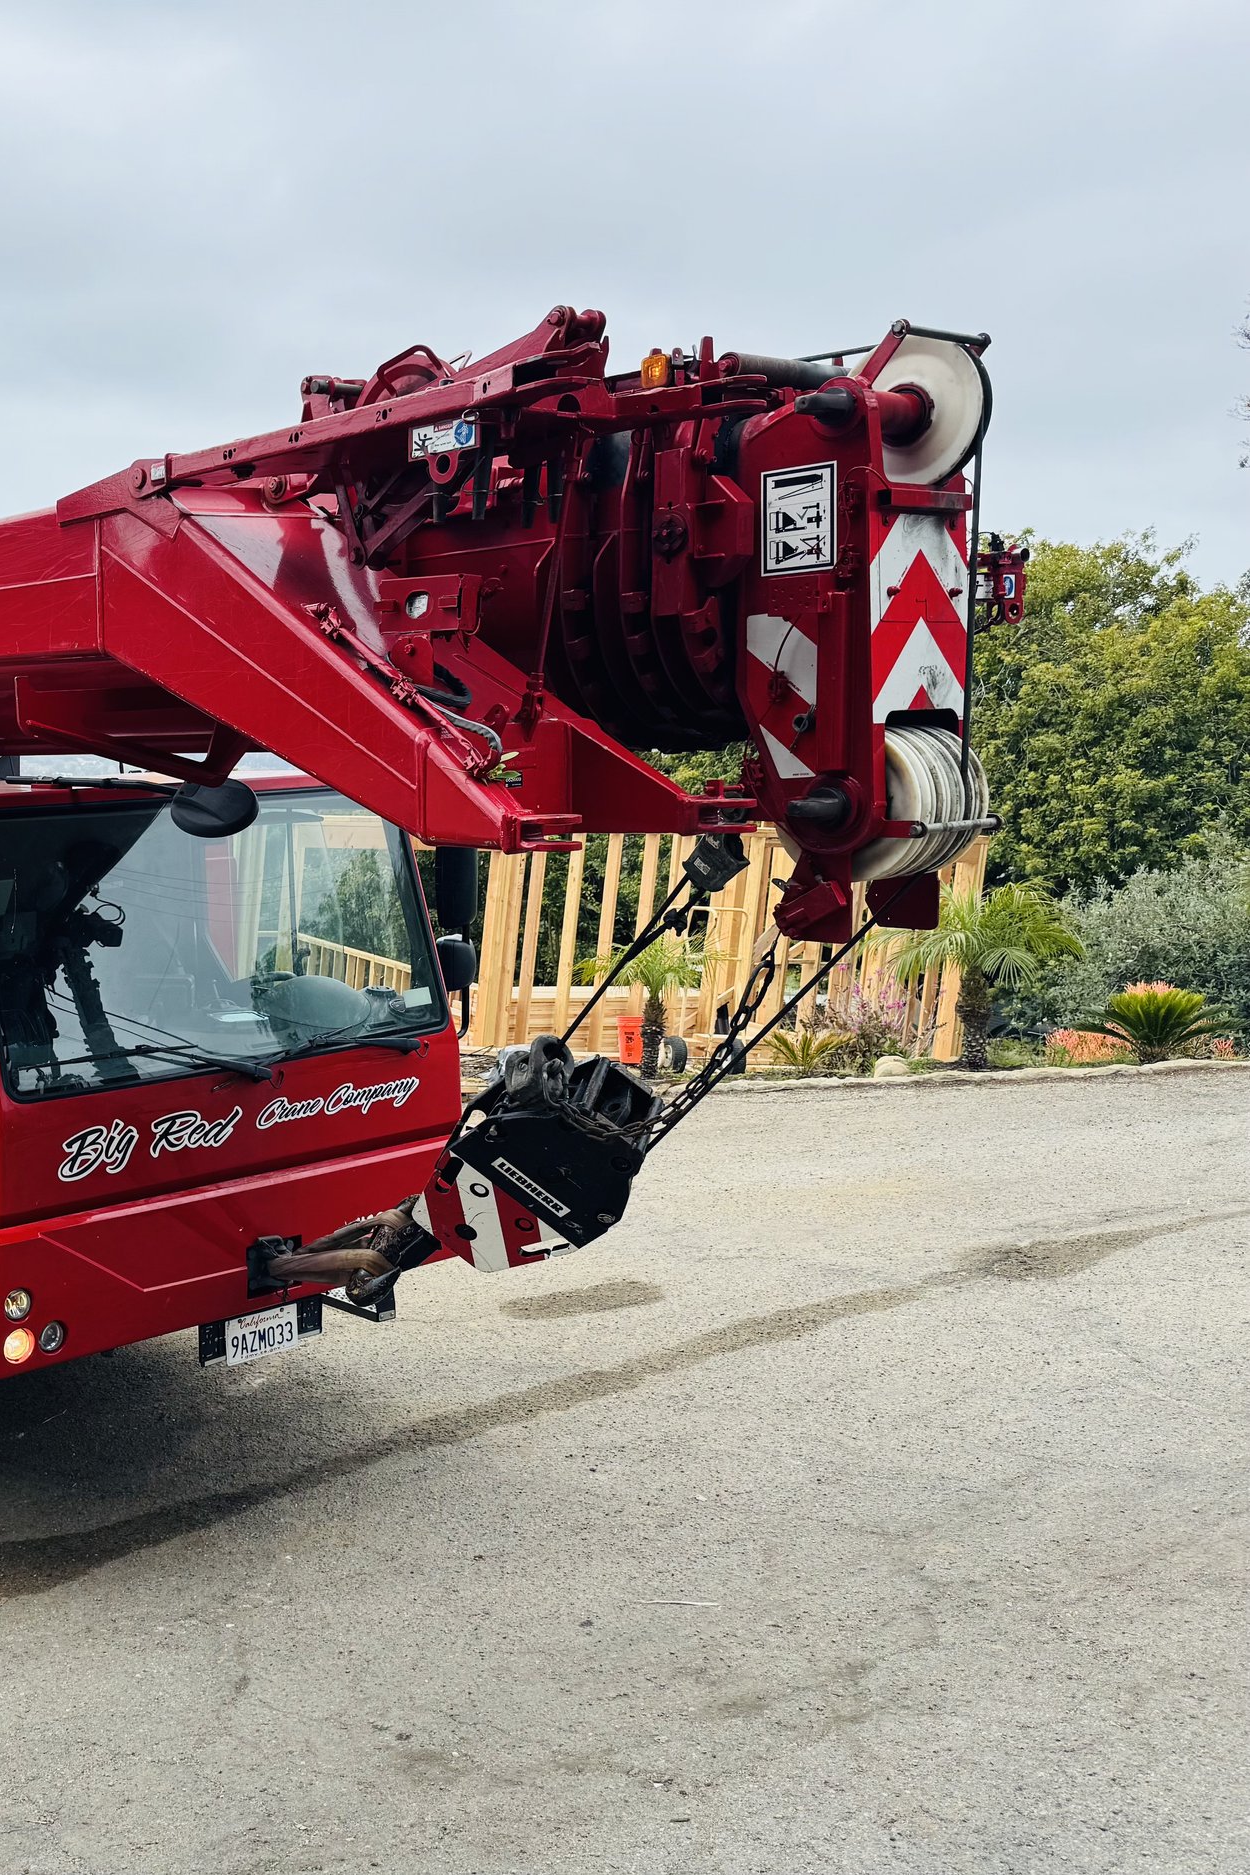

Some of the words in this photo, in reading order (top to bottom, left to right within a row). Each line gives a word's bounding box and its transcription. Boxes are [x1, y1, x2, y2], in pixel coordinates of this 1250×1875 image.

[58, 1119, 139, 1182] Big
[150, 1106, 242, 1158] Red
[256, 1097, 324, 1130] Crane
[325, 1076, 420, 1114] Company
[497, 1161, 565, 1215] LIEBHERR
[231, 1321, 294, 1359] 9AZM033
[239, 1312, 285, 1329] California
